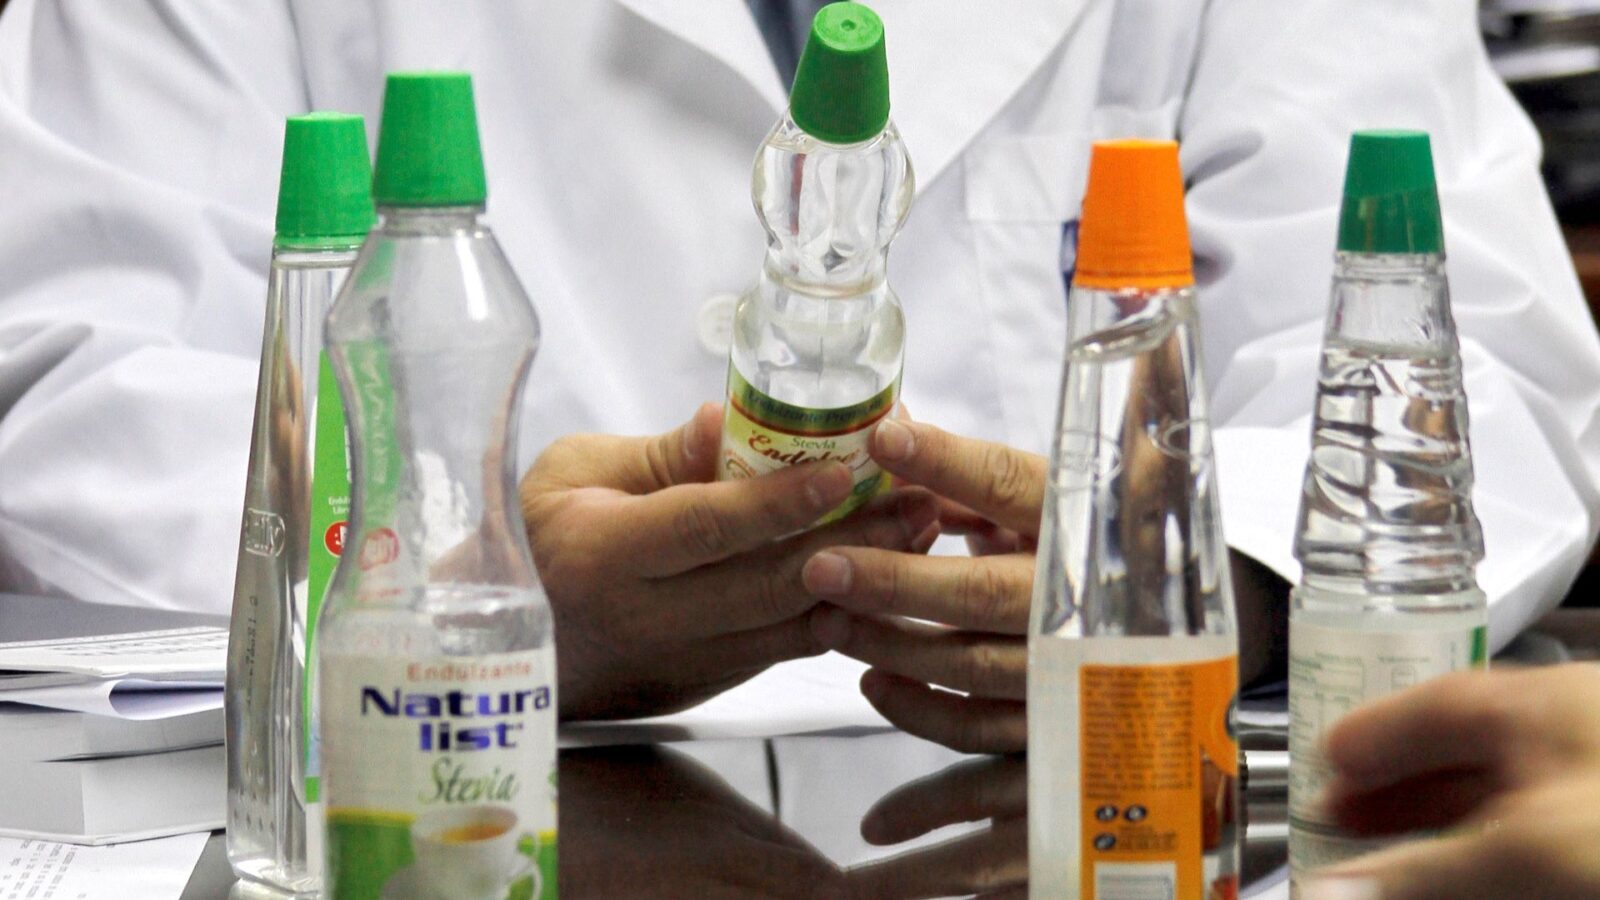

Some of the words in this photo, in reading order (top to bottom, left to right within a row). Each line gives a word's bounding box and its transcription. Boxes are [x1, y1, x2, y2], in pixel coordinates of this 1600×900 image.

[790, 436, 836, 450] Stevia
[406, 661, 533, 682] Endulzante
[360, 686, 551, 717] Natura
[420, 722, 518, 751] list
[419, 756, 517, 804] Stevia
